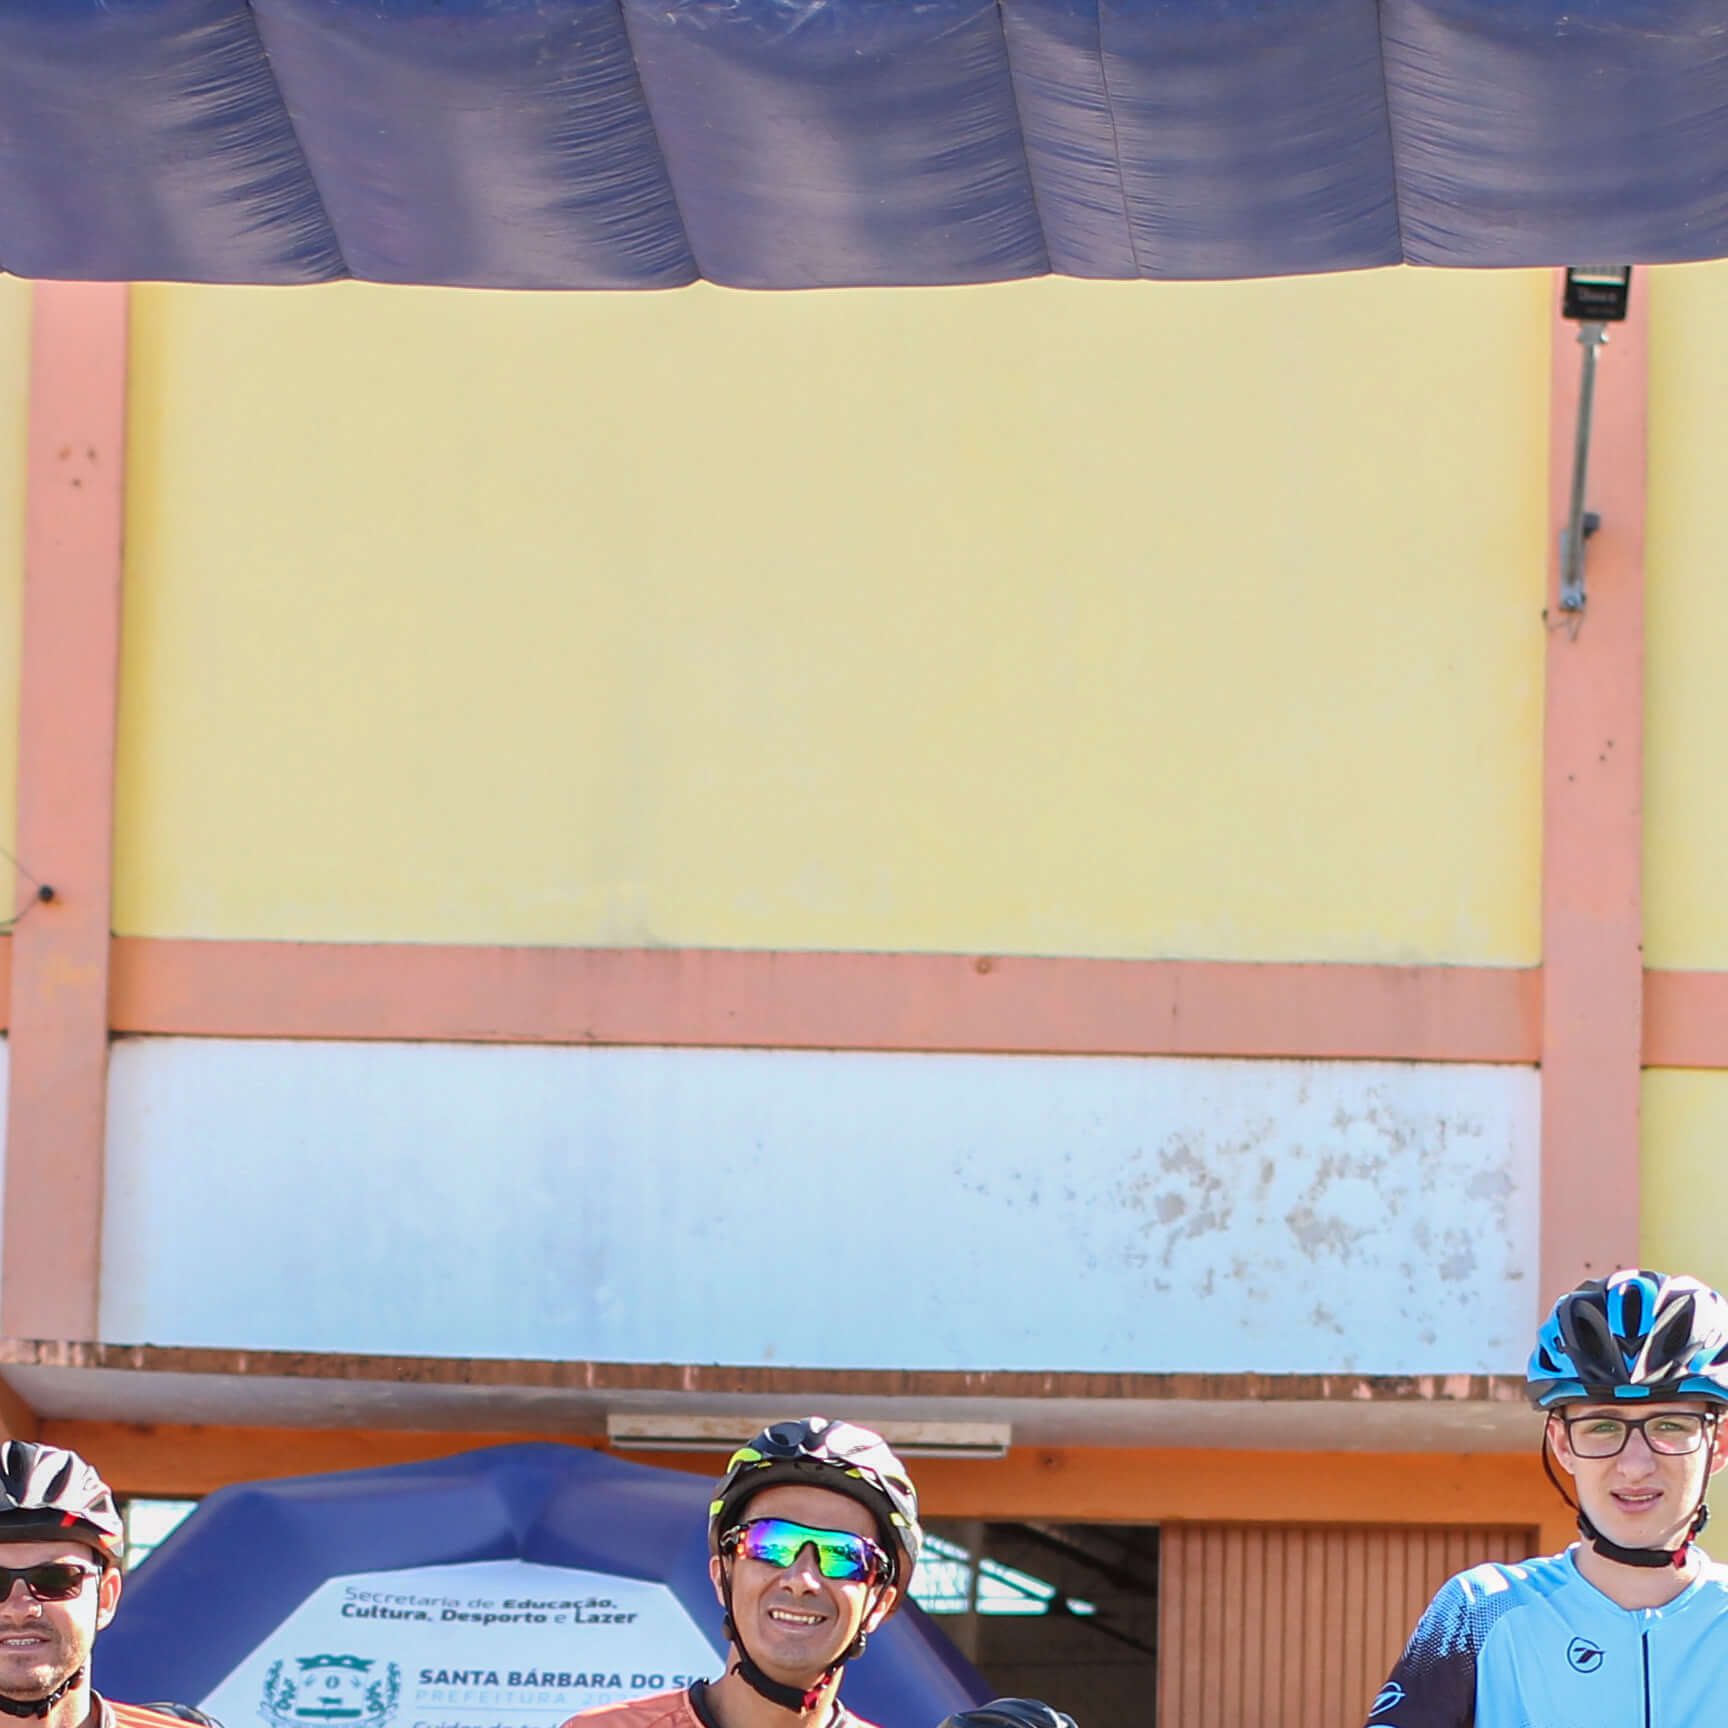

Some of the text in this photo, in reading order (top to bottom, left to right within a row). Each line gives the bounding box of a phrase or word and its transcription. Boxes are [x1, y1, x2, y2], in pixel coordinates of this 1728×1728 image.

[344, 1586, 460, 1608] Secretaria
[468, 1597, 495, 1609] de
[440, 1608, 548, 1626] Desporto
[554, 1612, 567, 1624] e
[574, 1608, 639, 1625] Lazer
[418, 1669, 500, 1687] SANTA
[507, 1668, 623, 1689] BÁRBARA
[630, 1673, 665, 1690] DO
